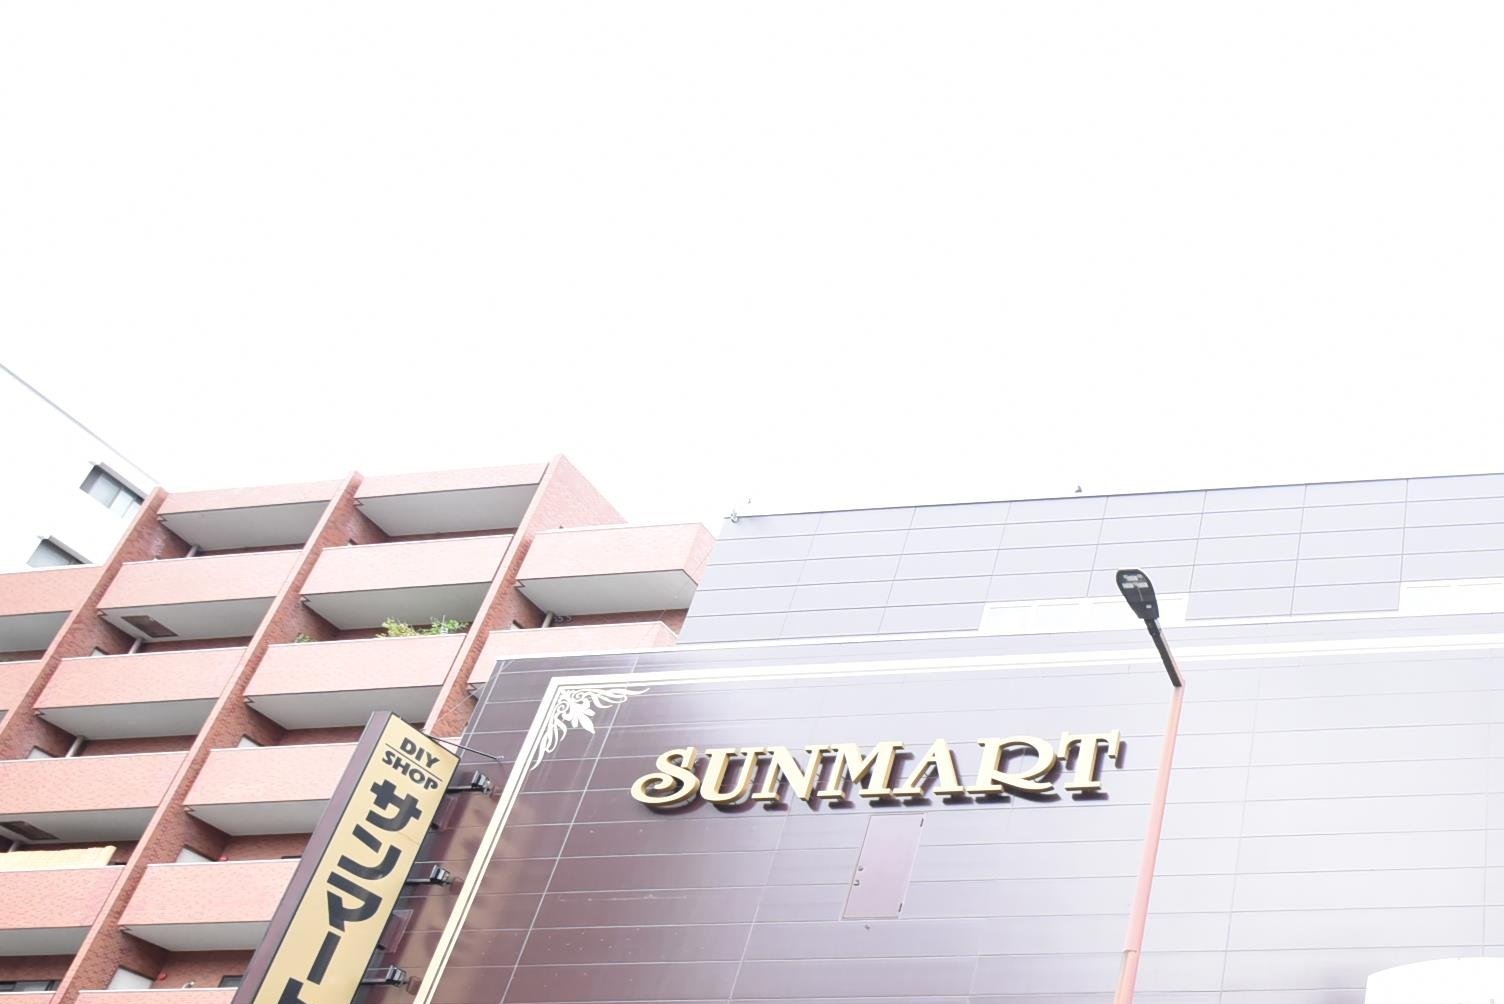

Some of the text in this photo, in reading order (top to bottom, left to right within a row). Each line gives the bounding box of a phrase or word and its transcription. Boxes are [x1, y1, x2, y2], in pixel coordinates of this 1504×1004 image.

[381, 751, 439, 790] SHOP
[399, 737, 440, 769] DIY
[629, 729, 1122, 805] SUNMART
